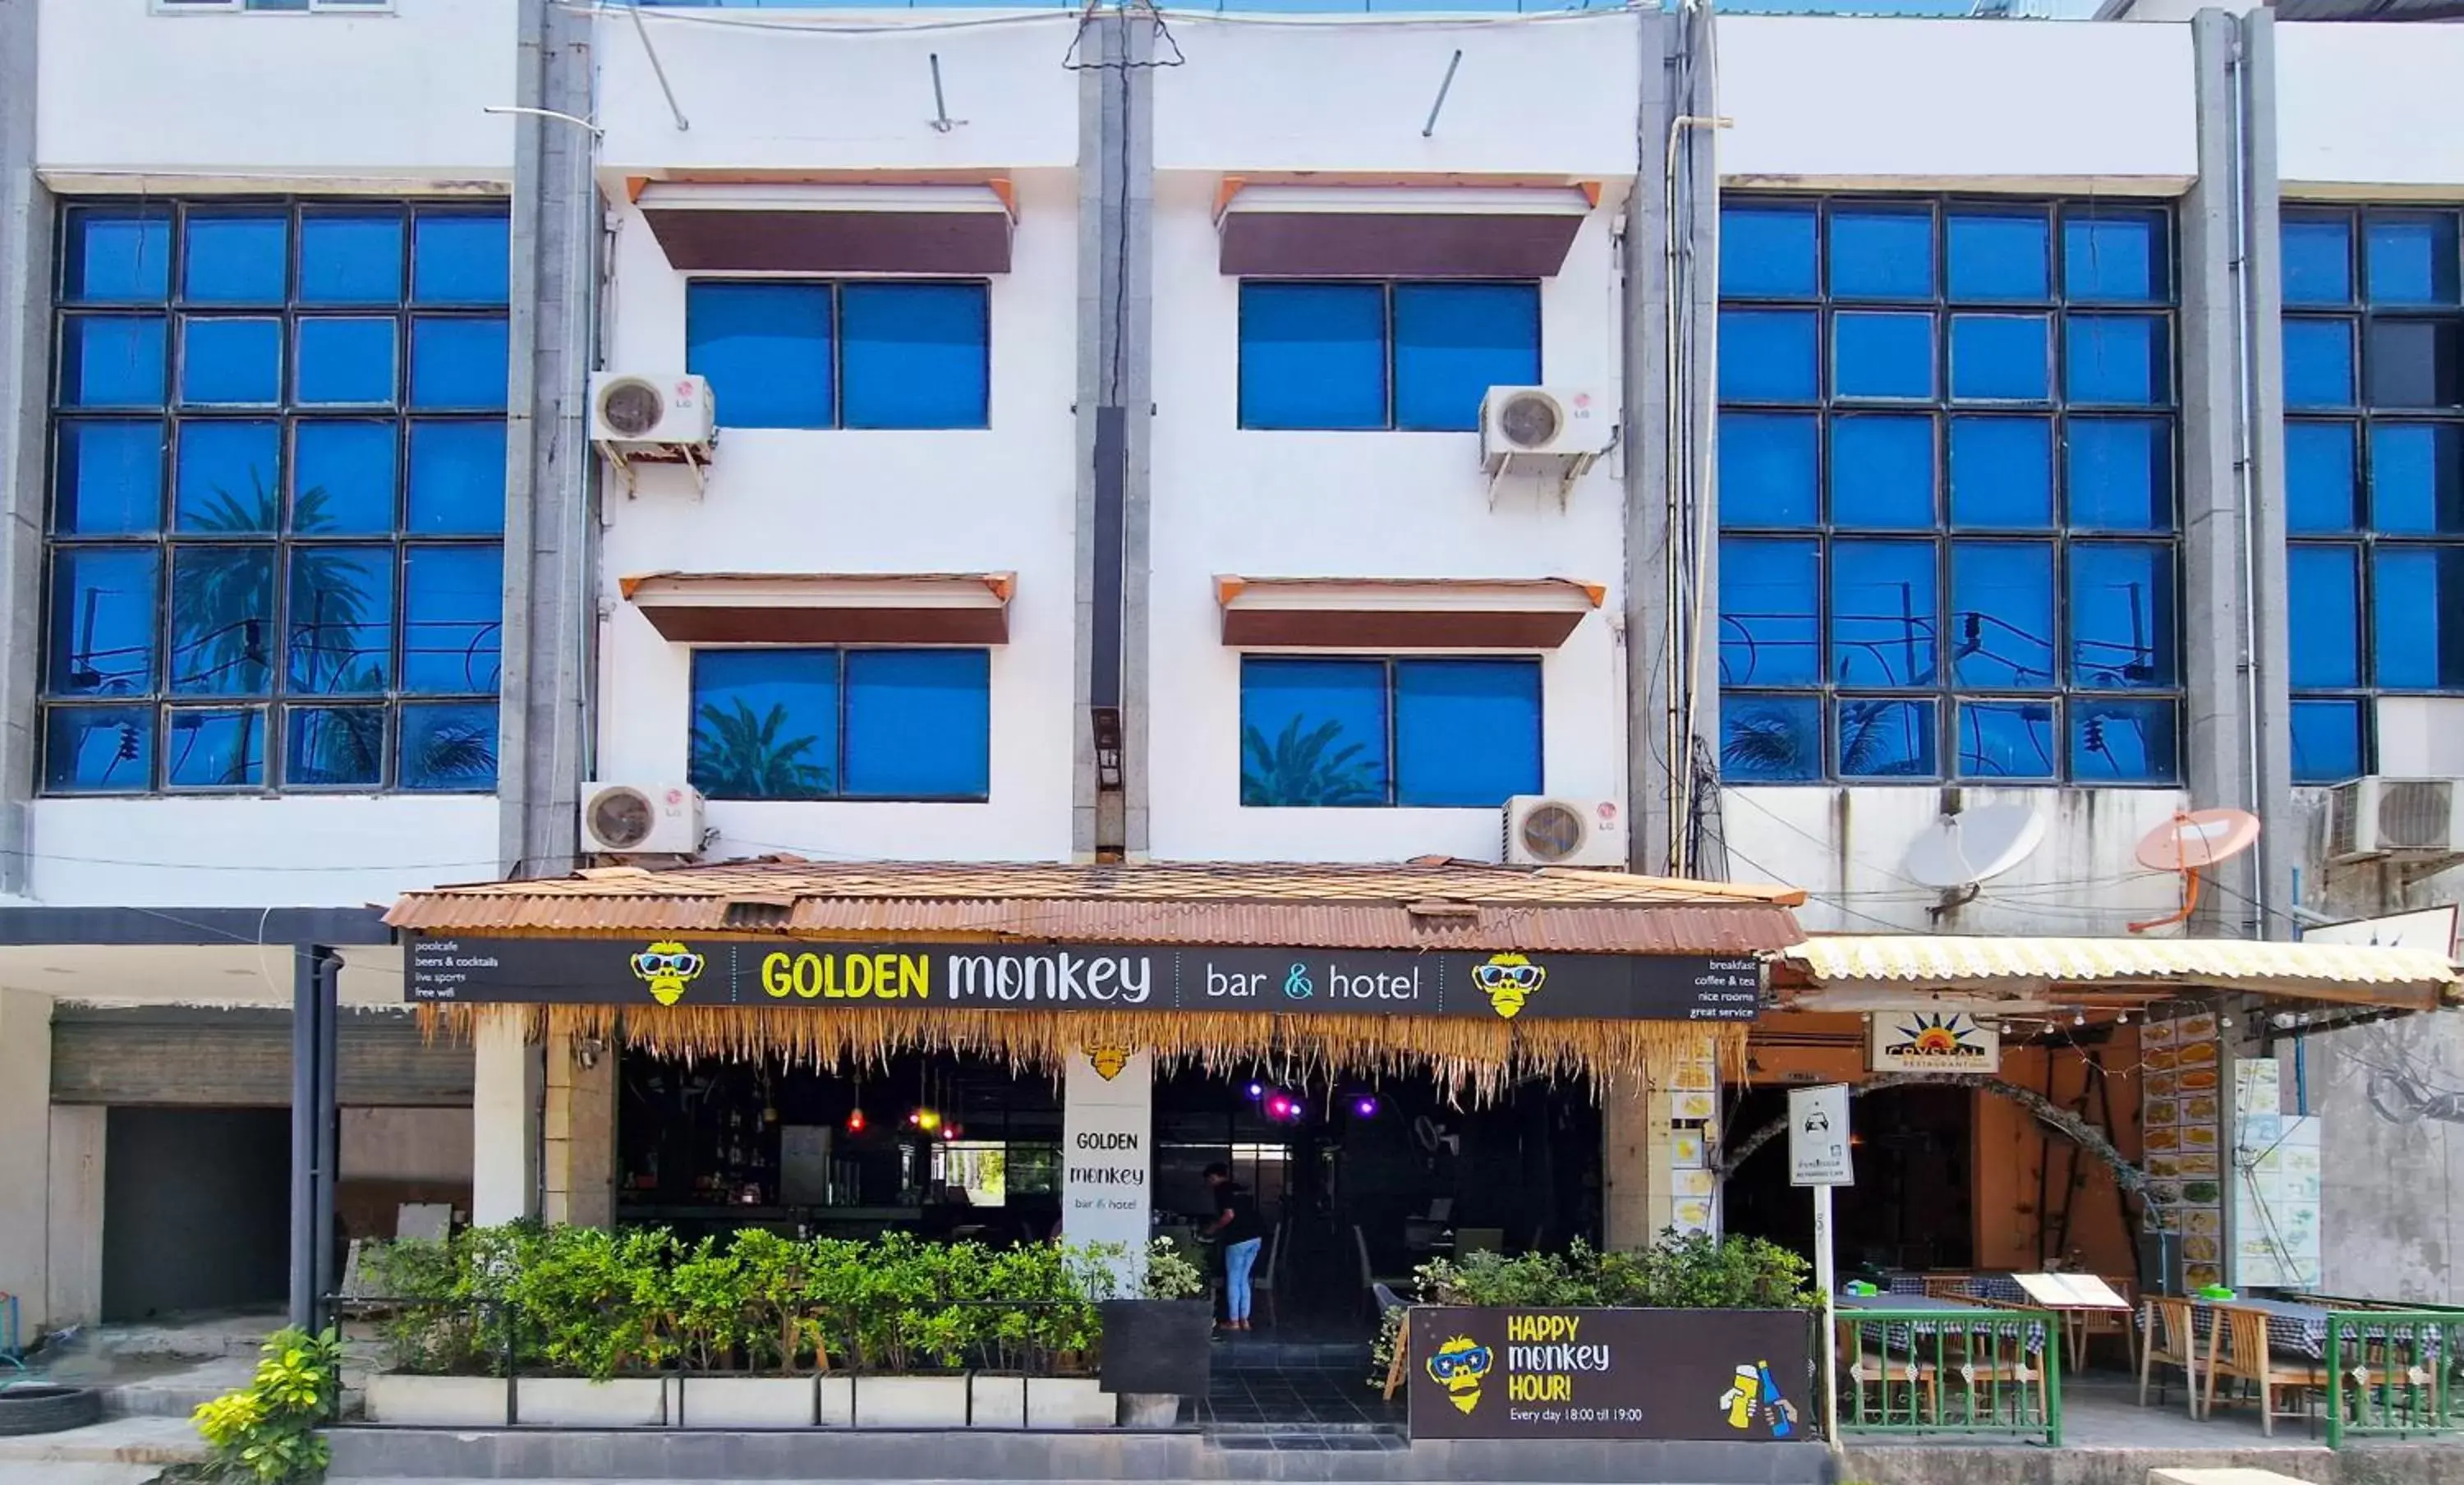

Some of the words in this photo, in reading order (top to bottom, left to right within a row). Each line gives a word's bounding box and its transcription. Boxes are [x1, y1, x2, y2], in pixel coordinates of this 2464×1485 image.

[676, 400, 692, 408] LG
[415, 957, 443, 967] beers
[445, 956, 453, 967] &
[456, 956, 499, 968] cocktails
[1709, 959, 1755, 970] breakfast
[415, 972, 431, 982] live
[434, 973, 466, 984] sports
[761, 952, 929, 999] GOLDEN
[949, 953, 1151, 1002] monkey
[1207, 963, 1267, 996] bar
[1285, 962, 1313, 1000] &
[1329, 964, 1418, 1000] hotel
[1694, 975, 1726, 986] coffee
[1728, 975, 1737, 986] &
[1739, 977, 1755, 986] tea
[415, 987, 434, 997] free
[1698, 992, 1719, 1001] nice
[1689, 1008, 1717, 1018] great
[1718, 1008, 1754, 1017] service
[1077, 1133, 1138, 1150] GOLDEN
[1070, 1167, 1144, 1185] monkey
[1075, 1198, 1093, 1208] bar
[1109, 1199, 1137, 1210] hotel
[1507, 1316, 1579, 1341] HAPPY
[1509, 1343, 1609, 1371] monkey
[1509, 1374, 1571, 1401] HOUR!
[1510, 1408, 1539, 1424] Every
[1542, 1408, 1561, 1423] day
[1565, 1409, 1594, 1421] 18:00
[1613, 1409, 1642, 1422] 19:00
